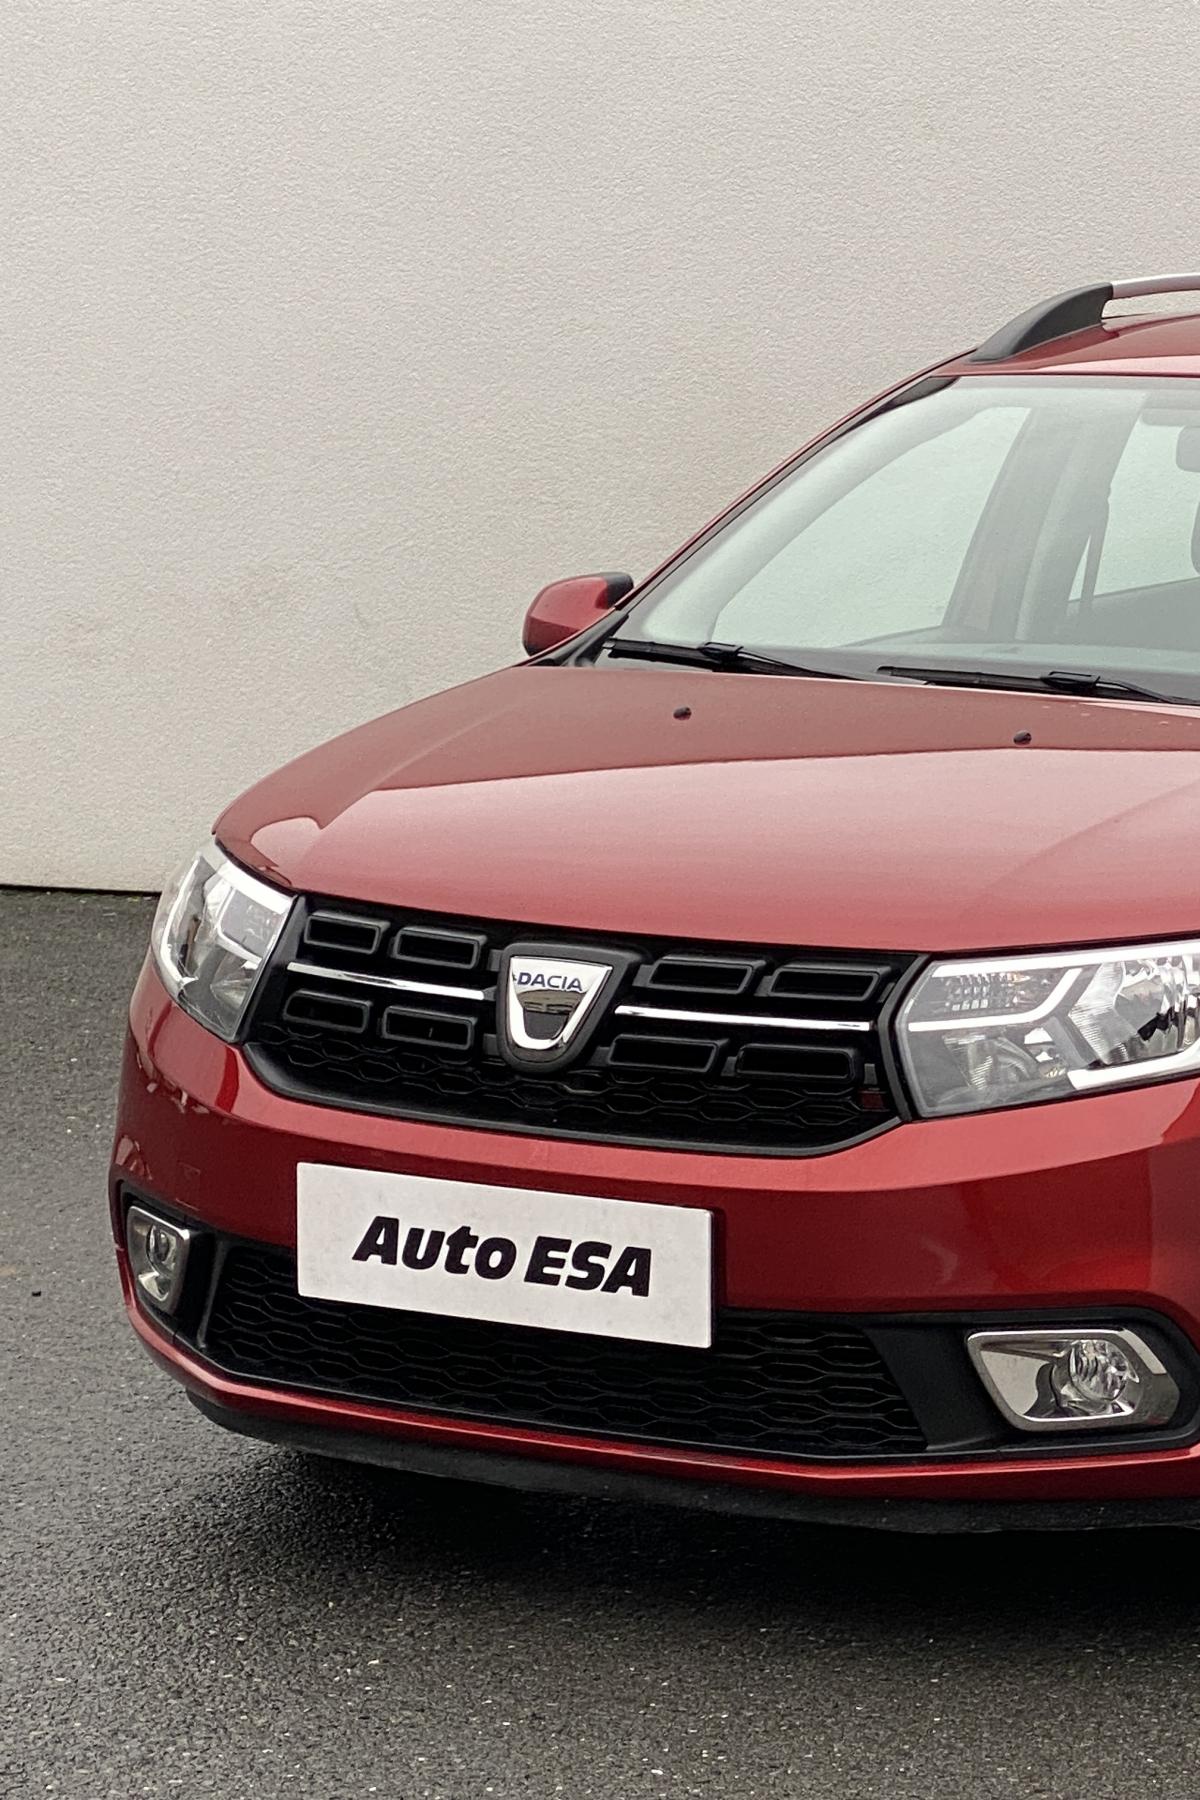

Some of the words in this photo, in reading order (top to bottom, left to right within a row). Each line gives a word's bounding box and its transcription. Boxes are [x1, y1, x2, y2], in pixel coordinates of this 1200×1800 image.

[517, 972, 583, 991] DACIA
[352, 1215, 517, 1280] Auto
[523, 1235, 652, 1298] ESA
